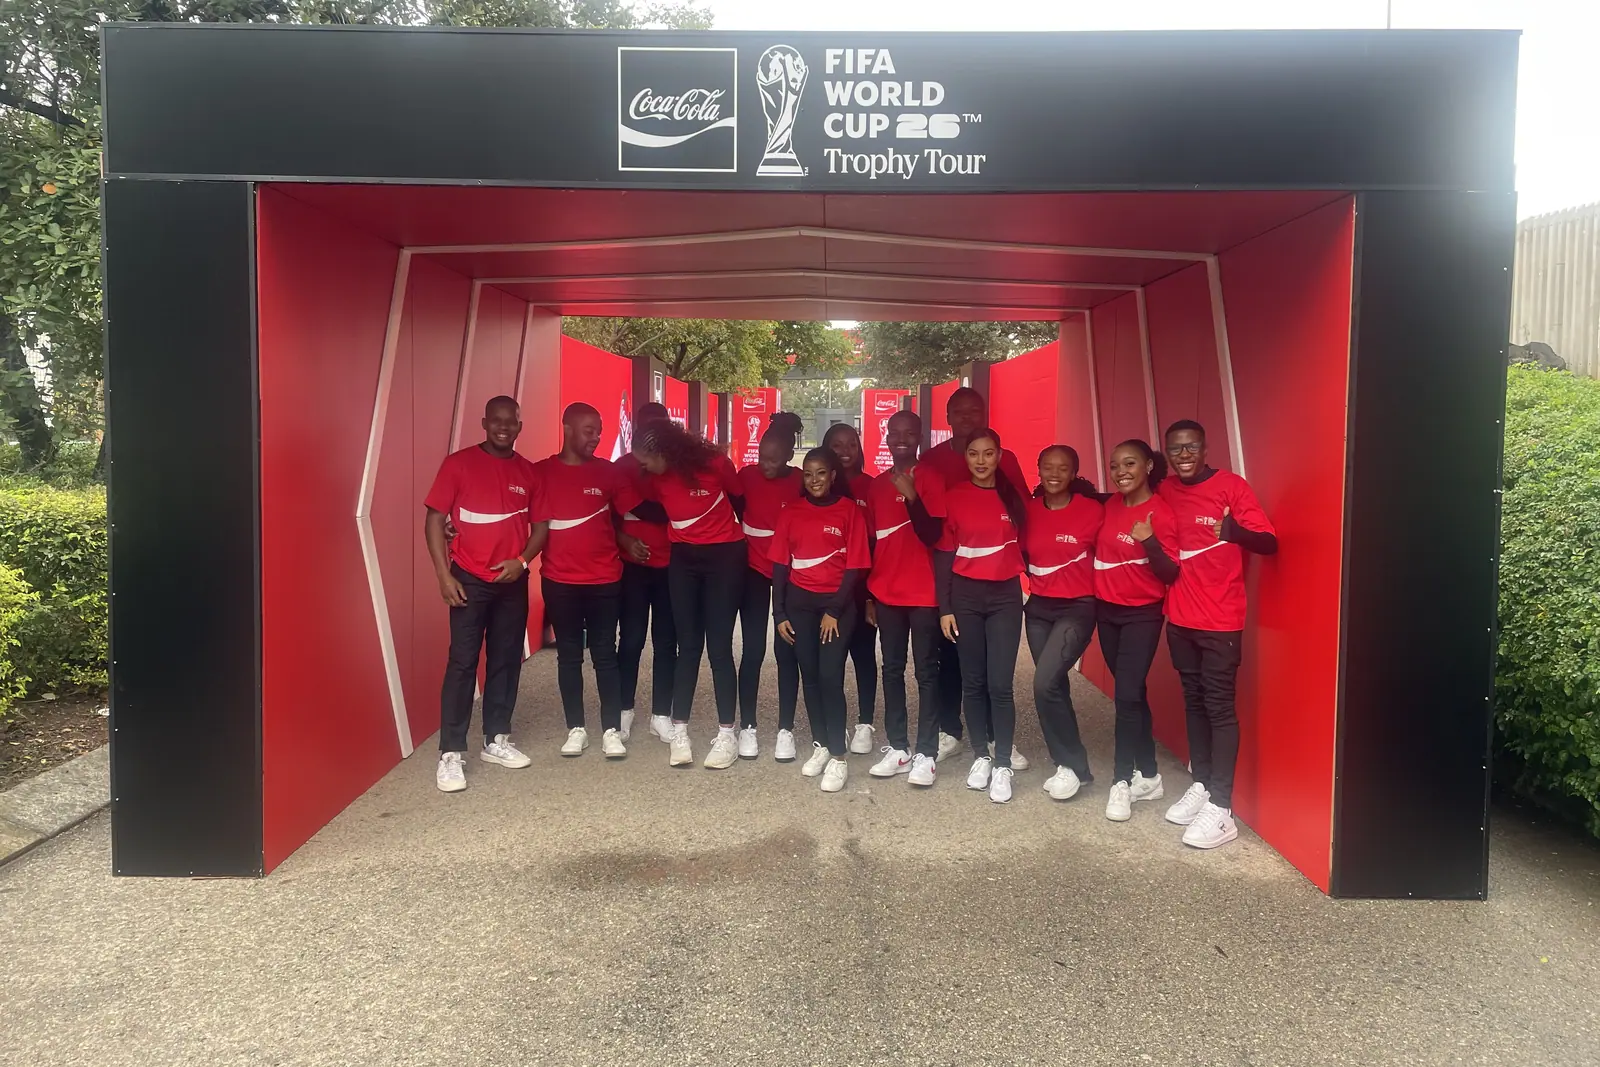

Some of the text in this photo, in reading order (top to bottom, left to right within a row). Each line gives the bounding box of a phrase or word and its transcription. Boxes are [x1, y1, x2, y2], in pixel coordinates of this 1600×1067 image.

[826, 48, 896, 74] FIFA
[629, 88, 726, 120] Coca-Cola
[824, 81, 944, 107] WORLD
[824, 113, 889, 138] CUP
[824, 148, 986, 179] Trophy Tour
